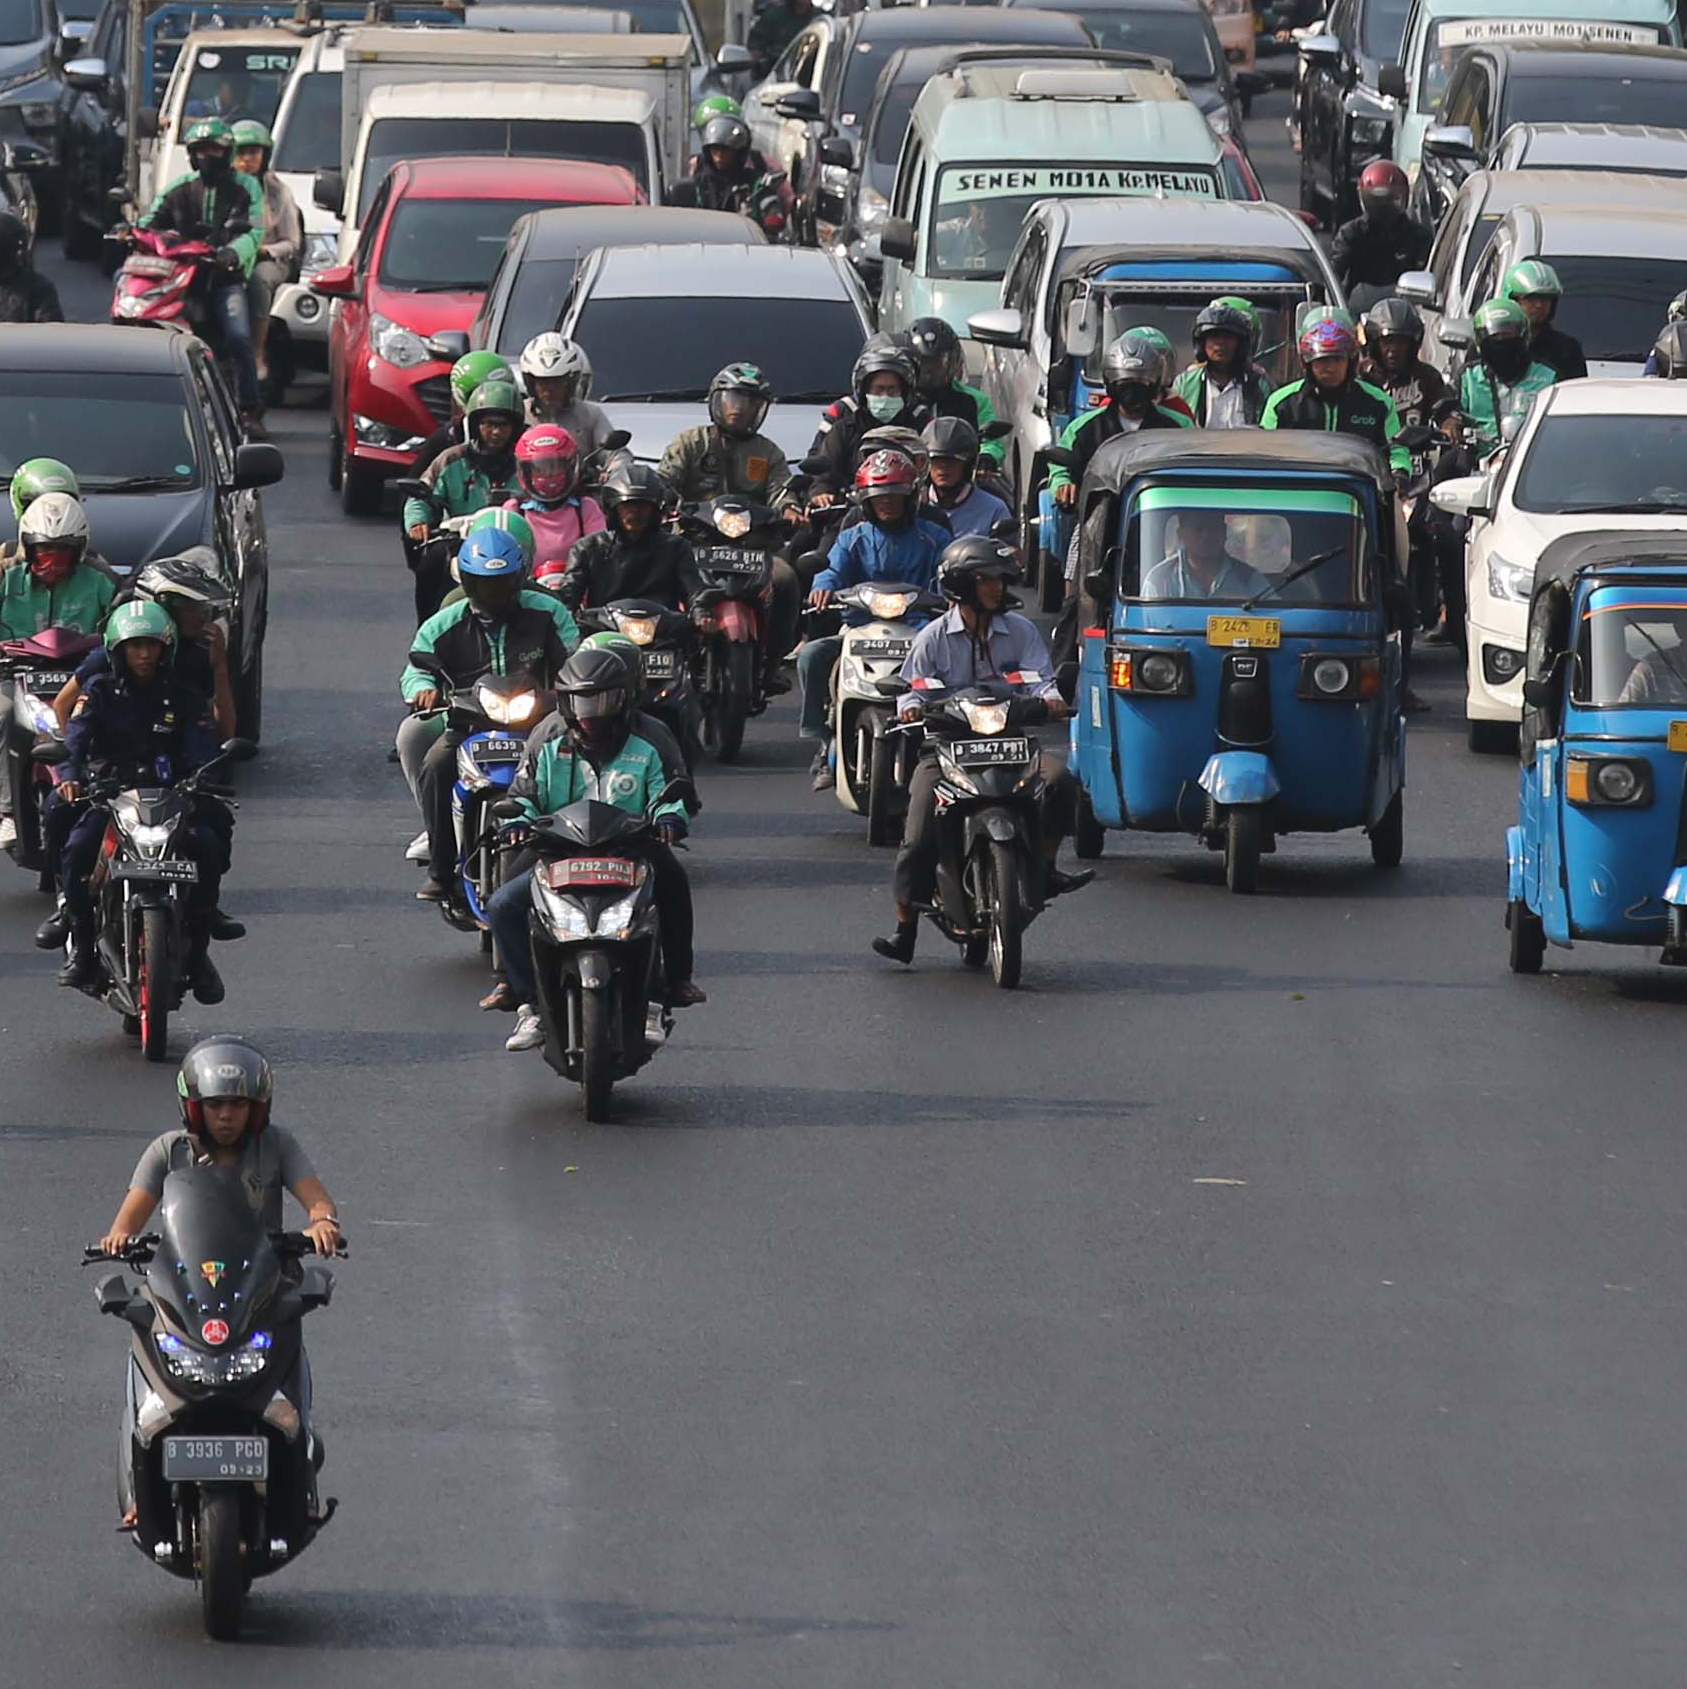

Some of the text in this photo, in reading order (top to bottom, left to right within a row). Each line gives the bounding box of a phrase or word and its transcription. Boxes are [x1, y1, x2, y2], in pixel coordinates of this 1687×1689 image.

[1488, 23, 1544, 36] MELAYU
[1588, 25, 1632, 41] SENEN
[956, 172, 1037, 191] SENEN
[1049, 171, 1111, 188] M01A
[1350, 414, 1375, 425] Grab
[167, 1441, 177, 1459] B
[186, 1441, 223, 1459] 3936
